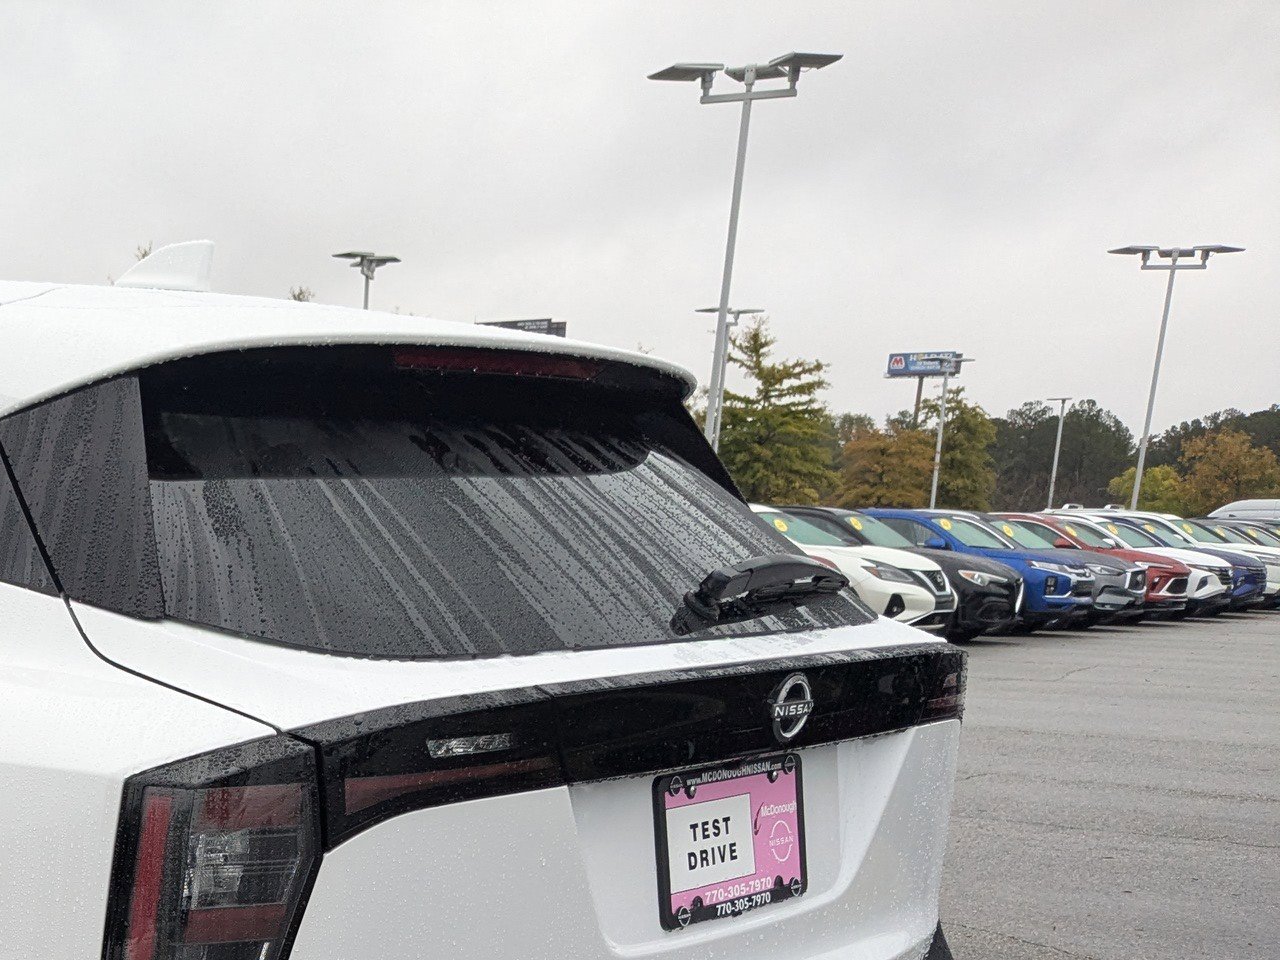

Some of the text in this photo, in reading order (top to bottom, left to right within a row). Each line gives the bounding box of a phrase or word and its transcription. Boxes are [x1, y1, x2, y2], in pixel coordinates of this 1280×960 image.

[760, 801, 797, 817] McDonough
[689, 816, 731, 842] TEST
[769, 836, 794, 847] NISSAN
[687, 842, 738, 871] DRIVE
[704, 876, 772, 904] 770-305-7970
[715, 892, 771, 916] 770-305-7970
